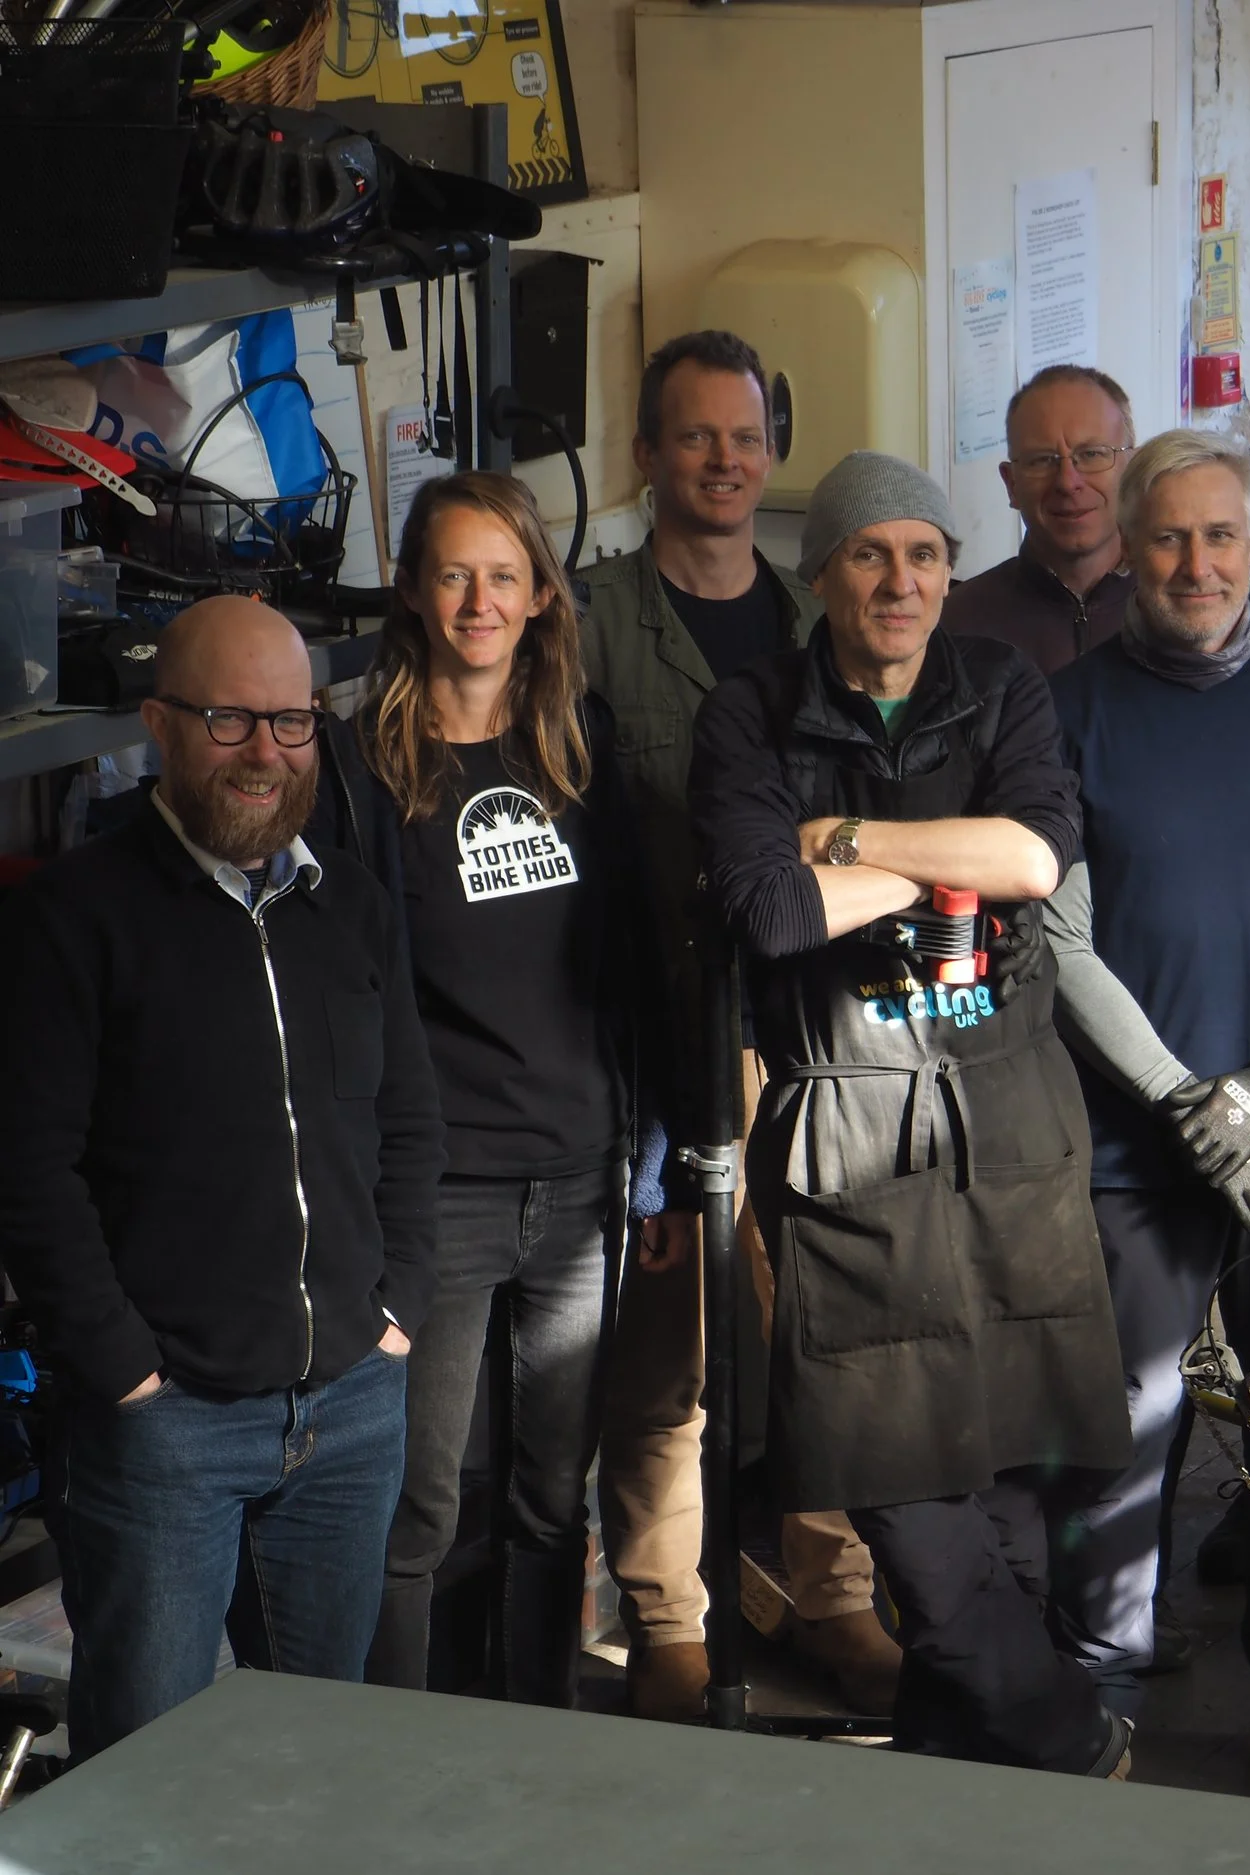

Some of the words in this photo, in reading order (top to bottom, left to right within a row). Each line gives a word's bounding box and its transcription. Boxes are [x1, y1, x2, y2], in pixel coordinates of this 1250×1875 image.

[467, 834, 557, 869] TOTNES
[467, 866, 521, 894] BIKE
[523, 855, 572, 884] HUB
[859, 980, 890, 998] we
[863, 982, 995, 1029] cycling
[954, 1012, 979, 1029] UK
